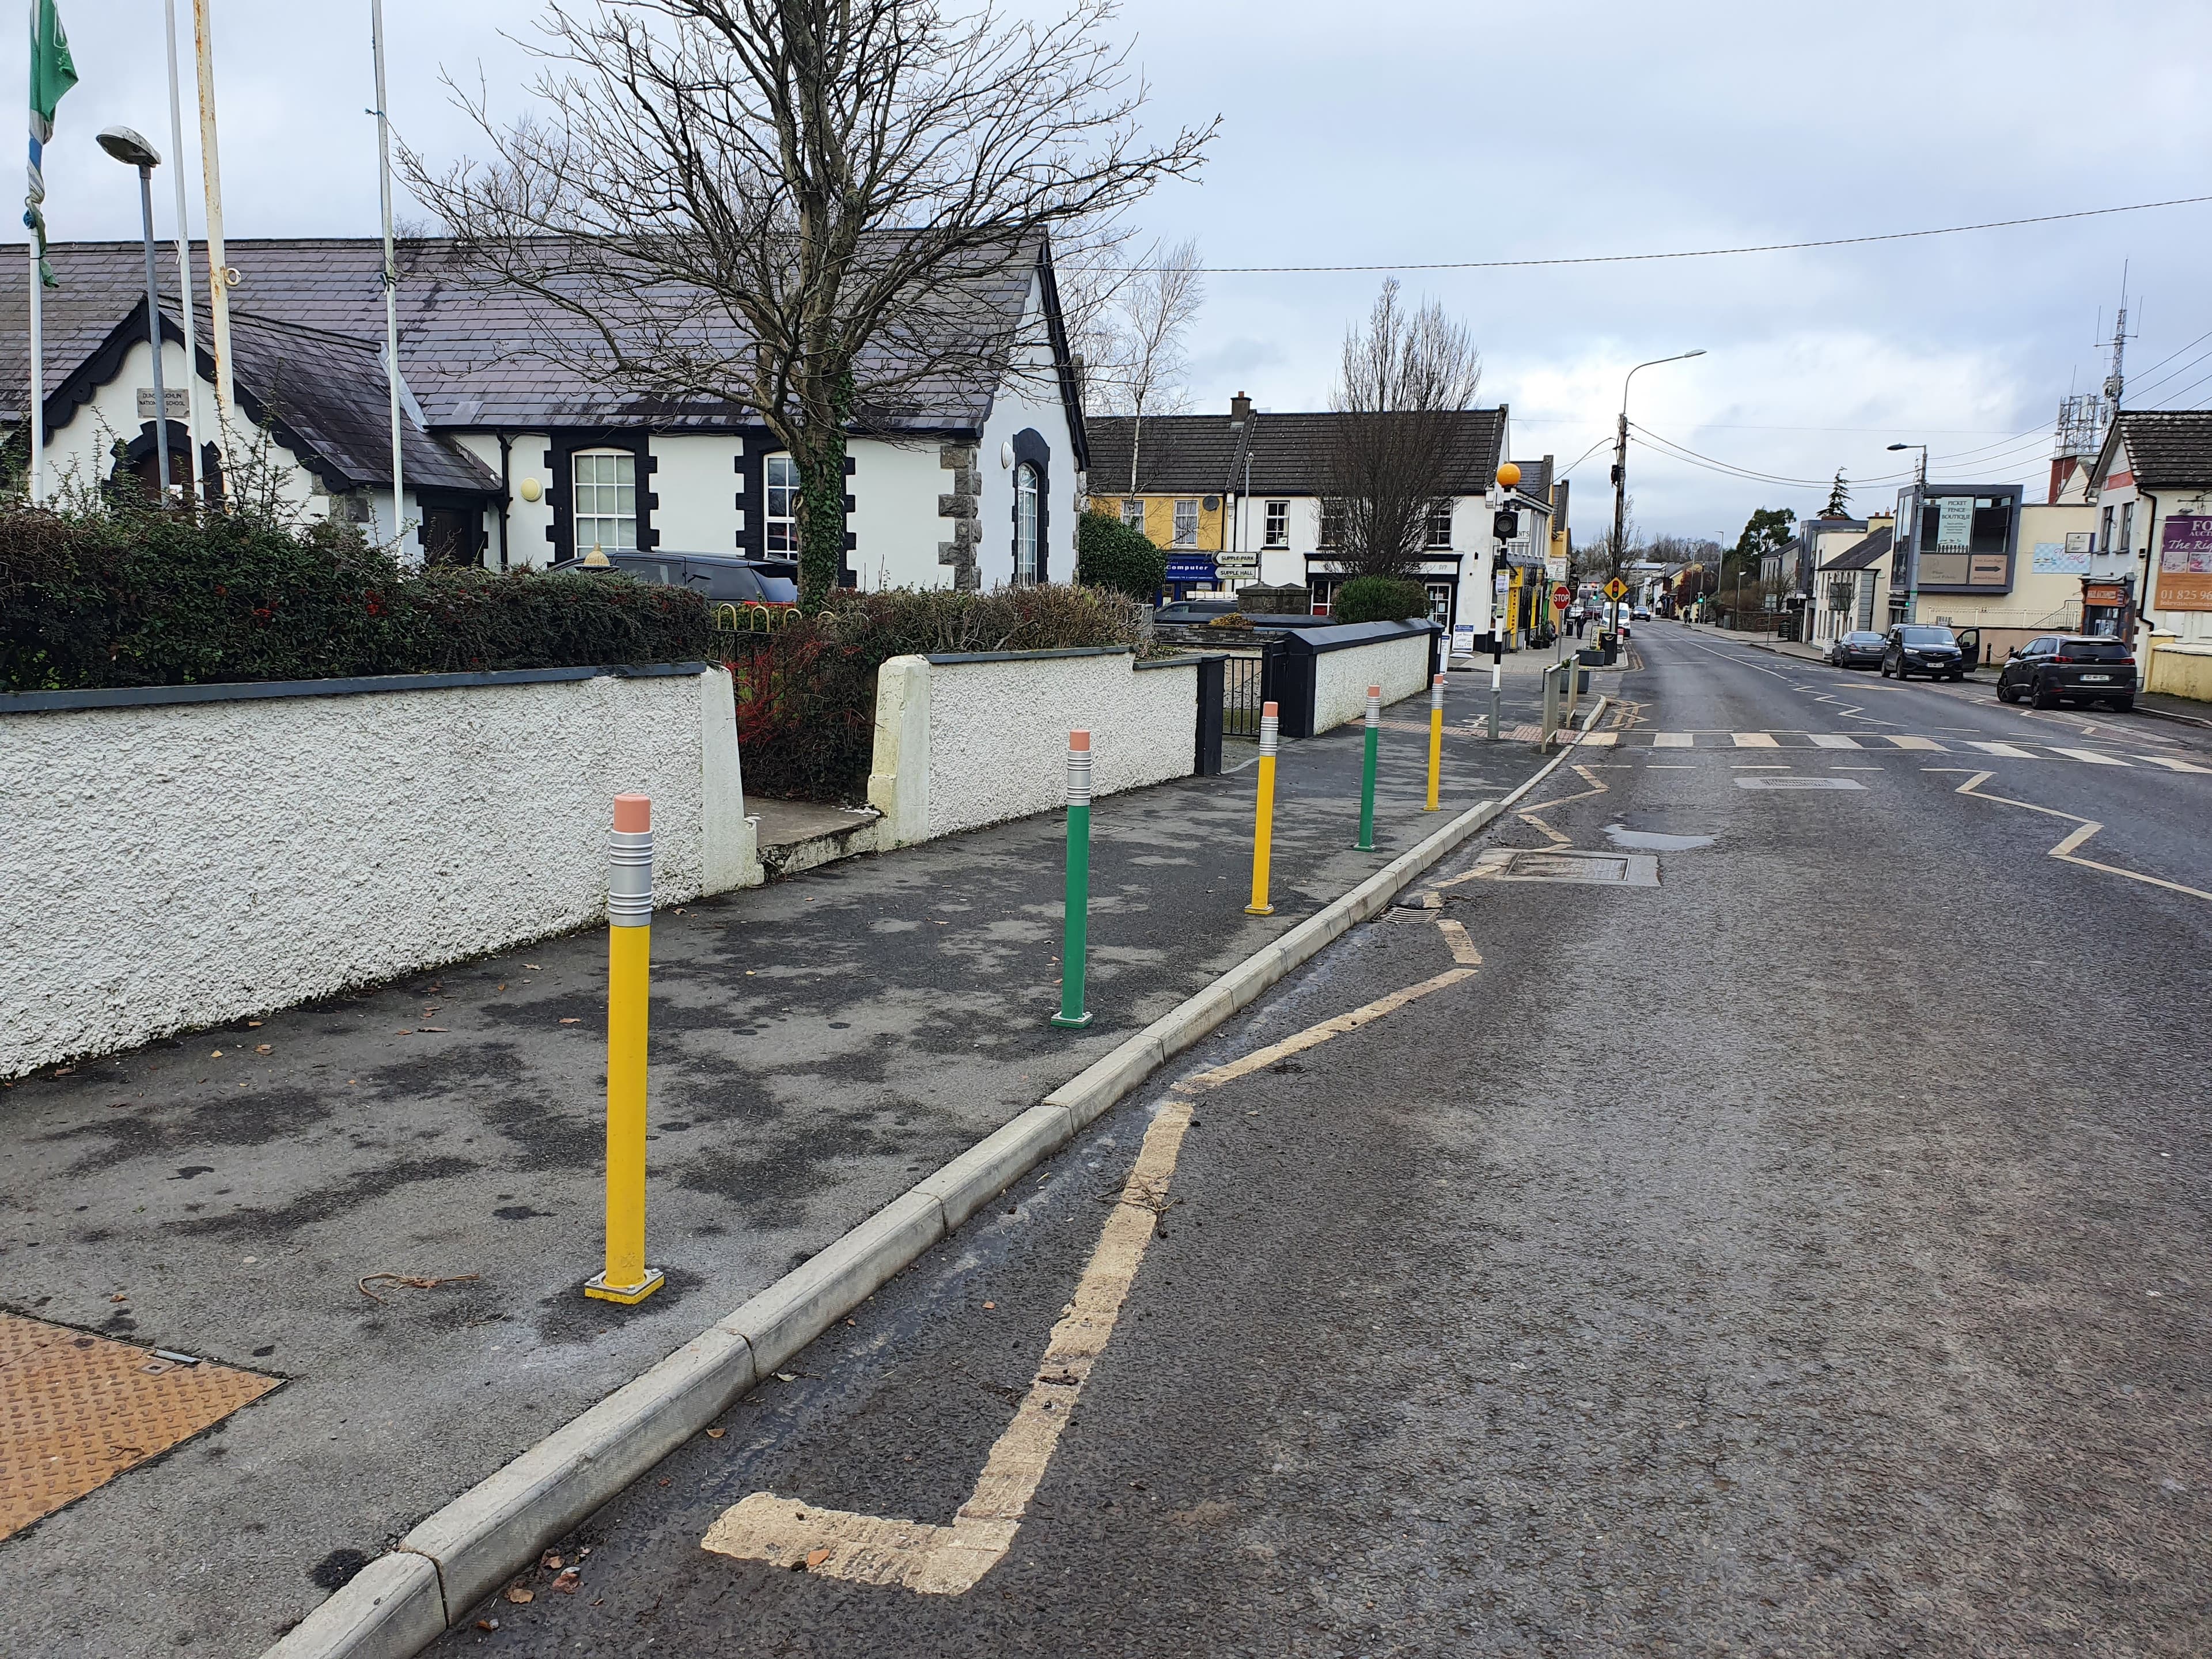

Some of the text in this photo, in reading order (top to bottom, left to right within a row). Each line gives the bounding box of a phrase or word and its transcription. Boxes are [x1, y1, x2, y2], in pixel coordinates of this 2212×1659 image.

[2168, 539, 2191, 550] The
[2161, 589, 2173, 600] 01
[2177, 590, 2198, 600] 825
